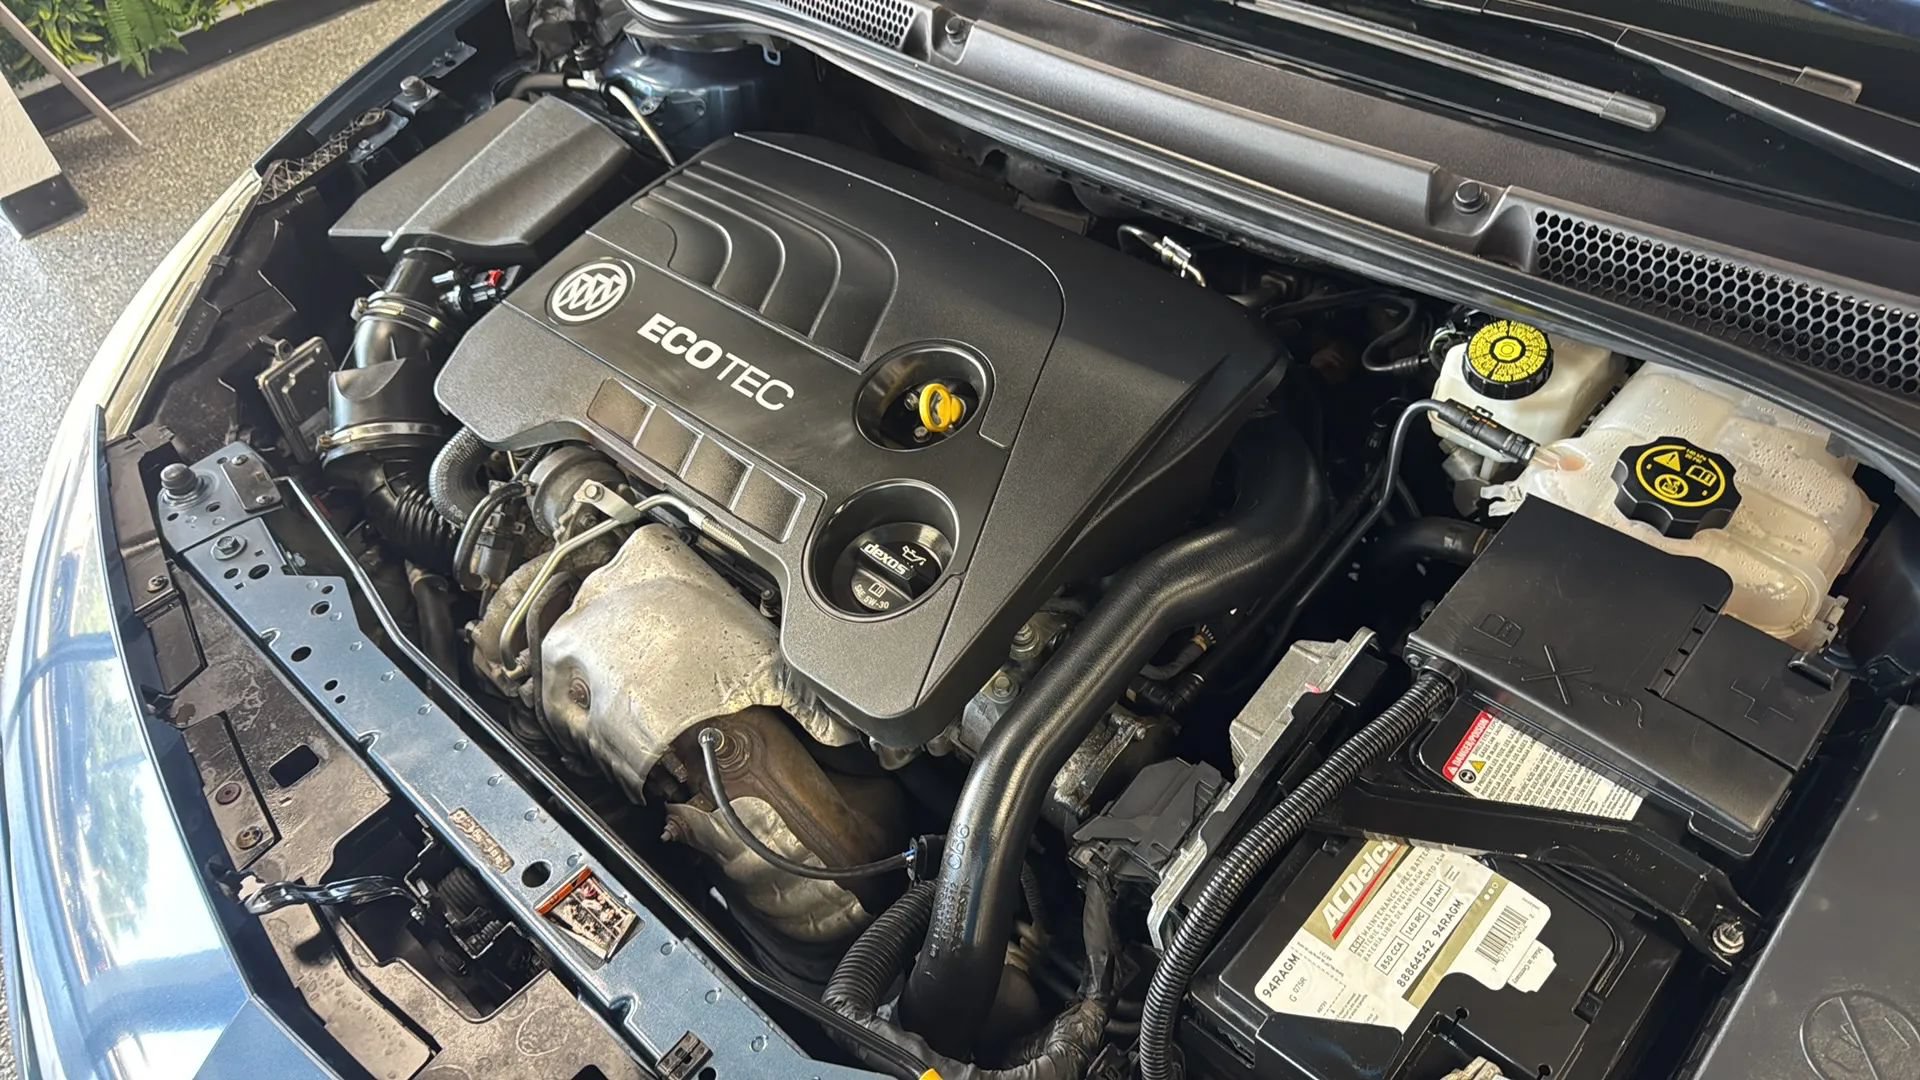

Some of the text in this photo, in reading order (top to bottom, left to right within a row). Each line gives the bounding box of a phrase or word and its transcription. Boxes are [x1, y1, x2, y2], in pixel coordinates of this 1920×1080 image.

[636, 312, 795, 411] ECOTEC
[864, 543, 910, 575] dexos
[855, 584, 890, 609] SAE 5W-30
[1451, 716, 1489, 767] DANGER/POISON
[1360, 887, 1401, 937] MAINTENANCE
[1396, 870, 1413, 890] FREE
[1409, 845, 1432, 872] BATTER
[1425, 895, 1436, 907] 80
[1394, 937, 1436, 988] 88864542
[1430, 898, 1465, 940] 94RAGM
[1404, 911, 1426, 936] 140 RC
[1261, 951, 1300, 999] 94RAGM
[1379, 940, 1404, 970] 850 CCA
